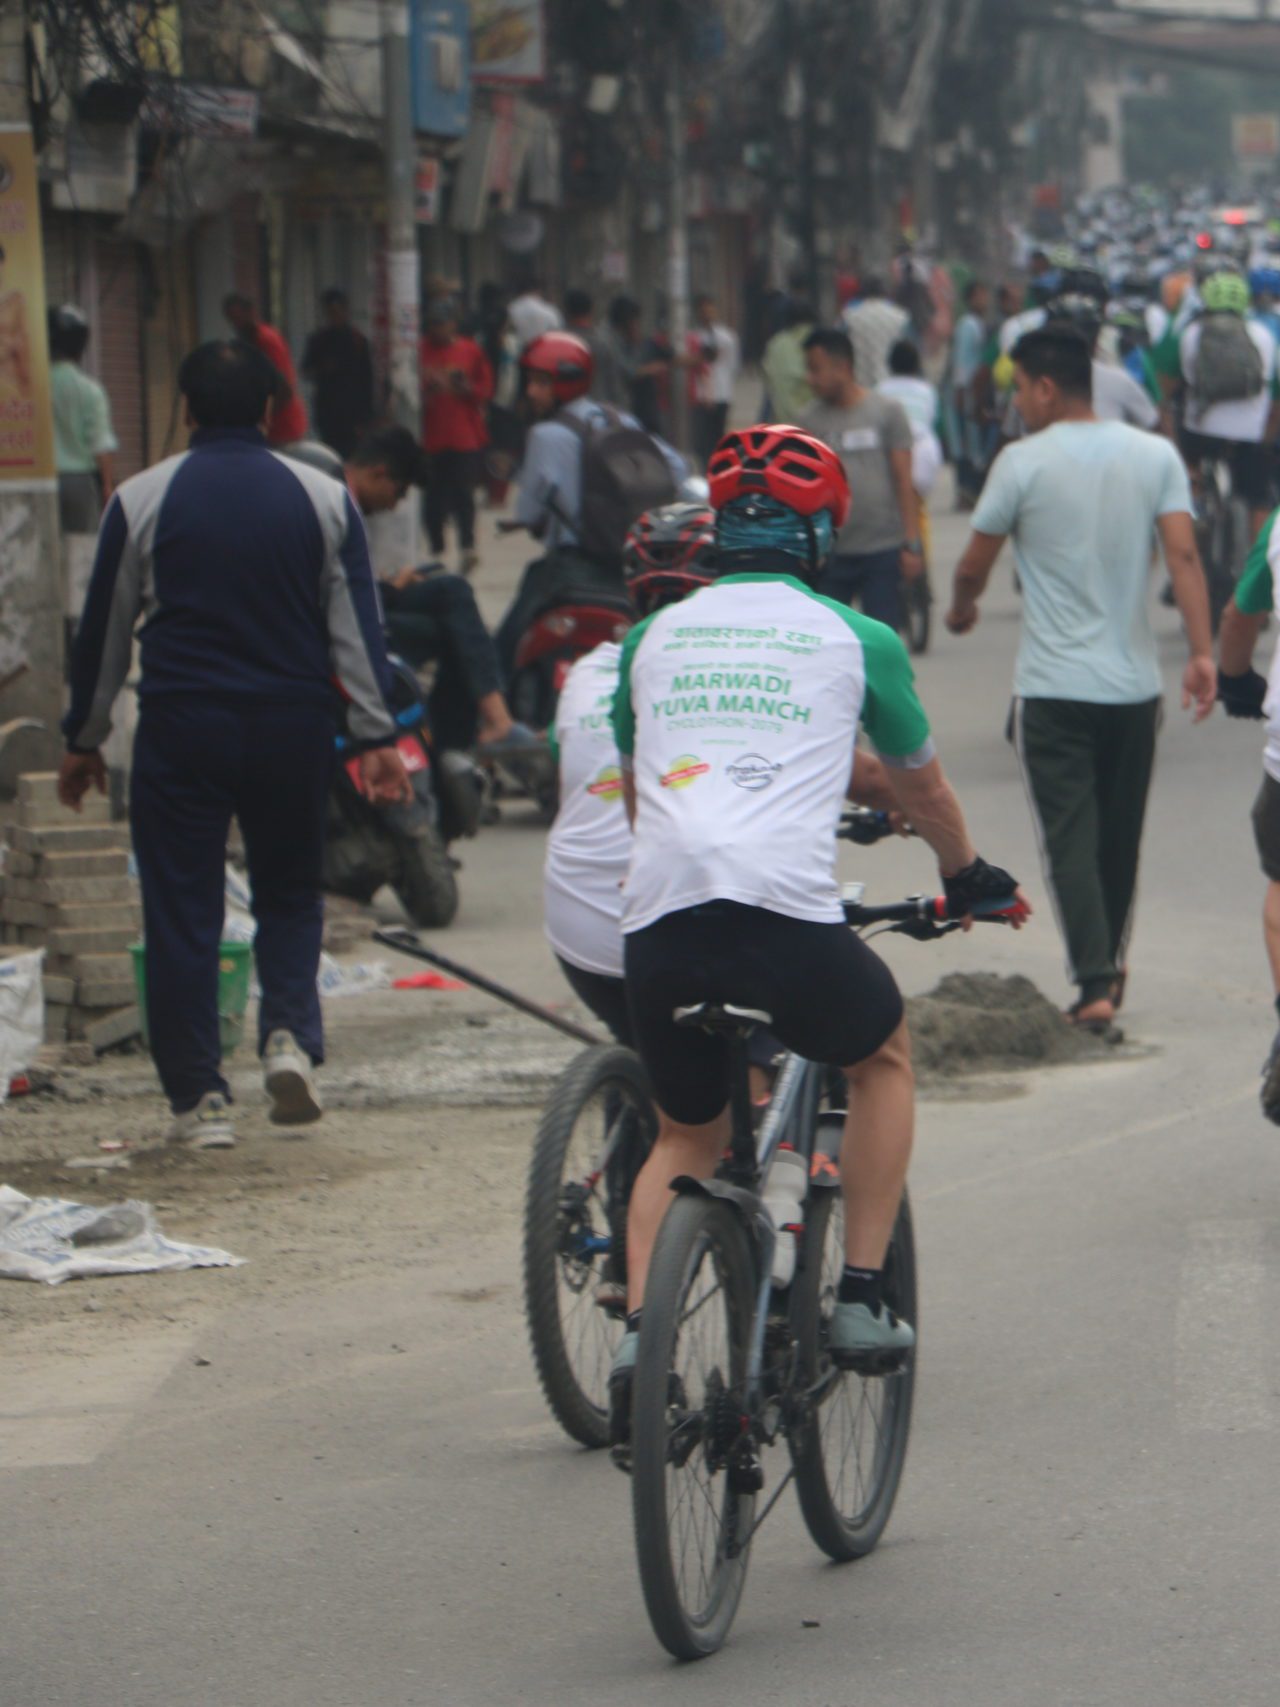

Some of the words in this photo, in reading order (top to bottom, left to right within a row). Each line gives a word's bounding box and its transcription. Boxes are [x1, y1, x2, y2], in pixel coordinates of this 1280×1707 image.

[671, 672, 792, 696] MARWADI
[652, 695, 710, 719] YUVA
[716, 694, 812, 724] MANCH
